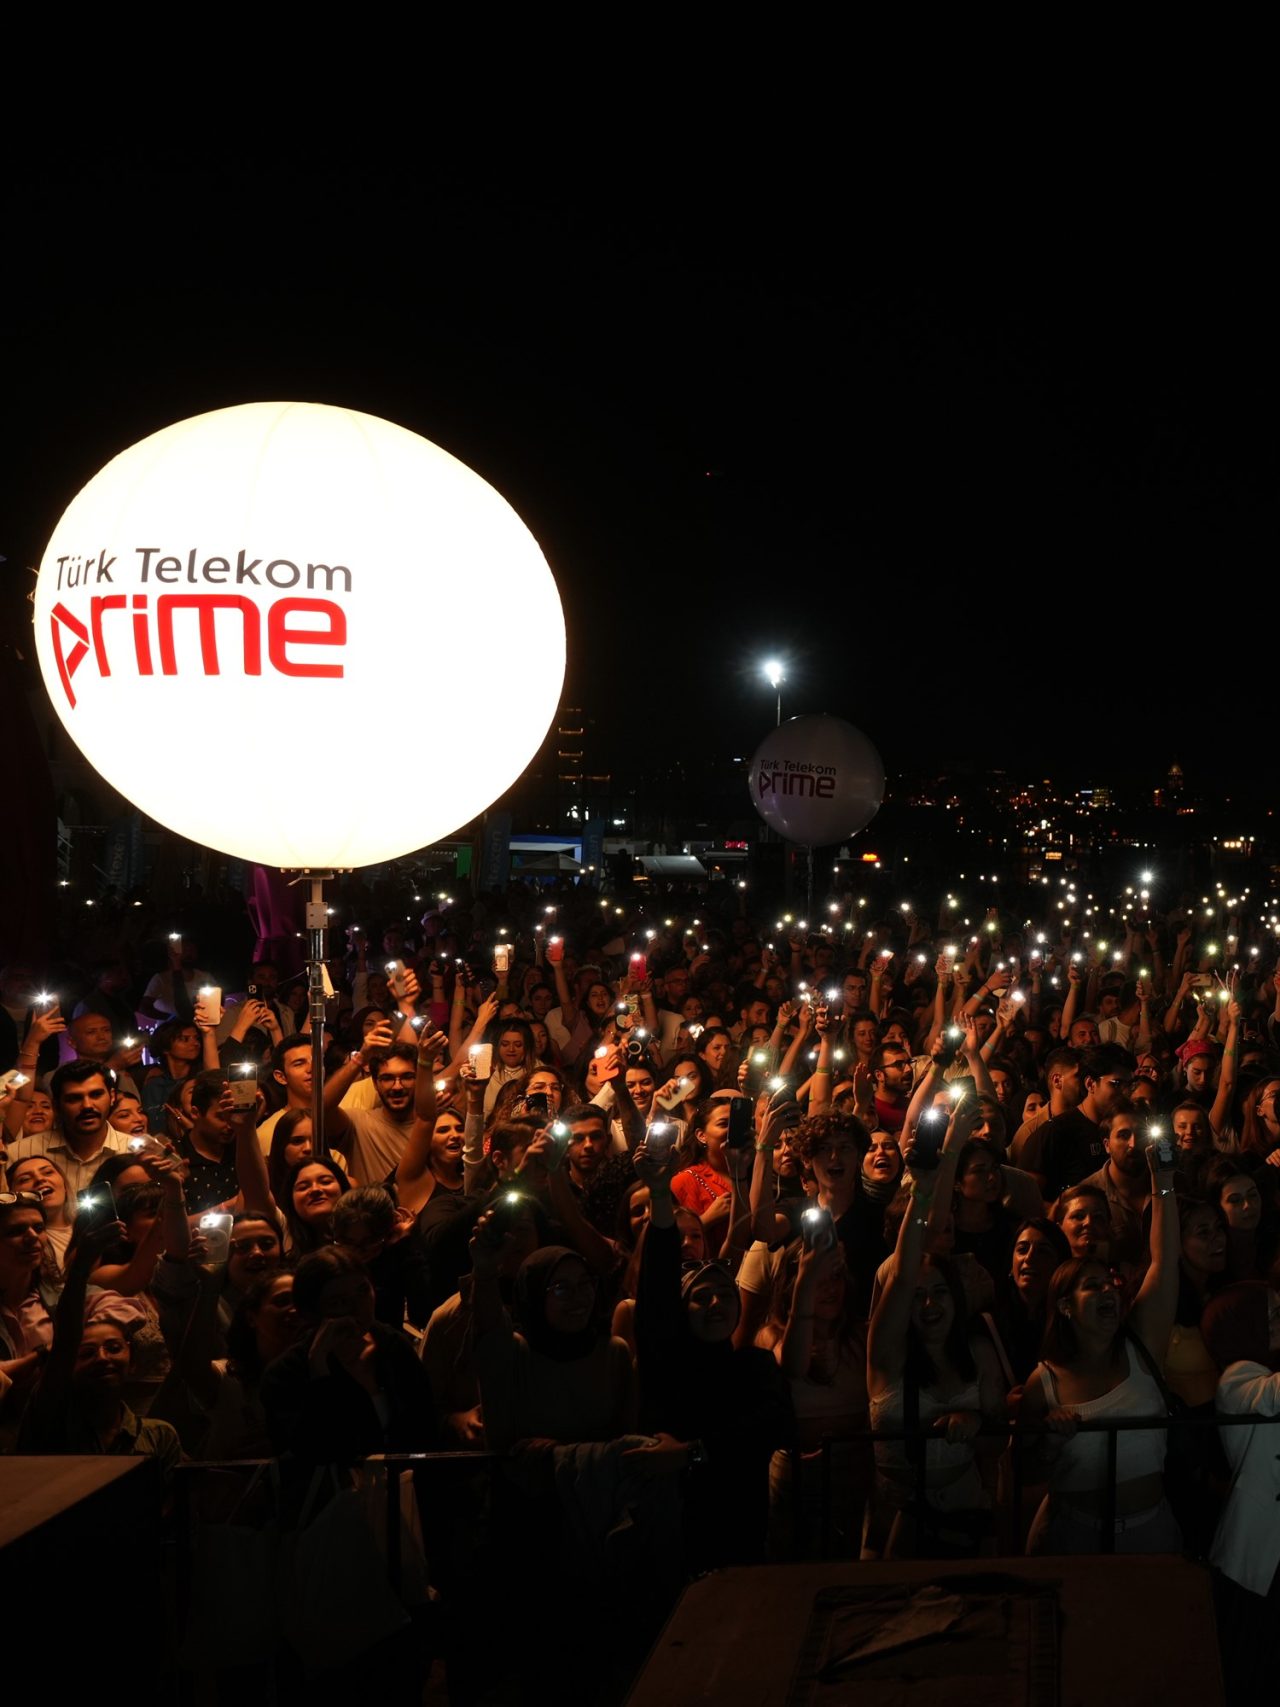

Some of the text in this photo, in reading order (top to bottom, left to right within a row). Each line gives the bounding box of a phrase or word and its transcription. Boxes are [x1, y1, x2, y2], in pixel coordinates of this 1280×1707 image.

[57, 547, 352, 592] Türk Telekom
[50, 594, 347, 711] prime
[759, 771, 836, 799] prime
[760, 759, 836, 776] Türk Telekom
